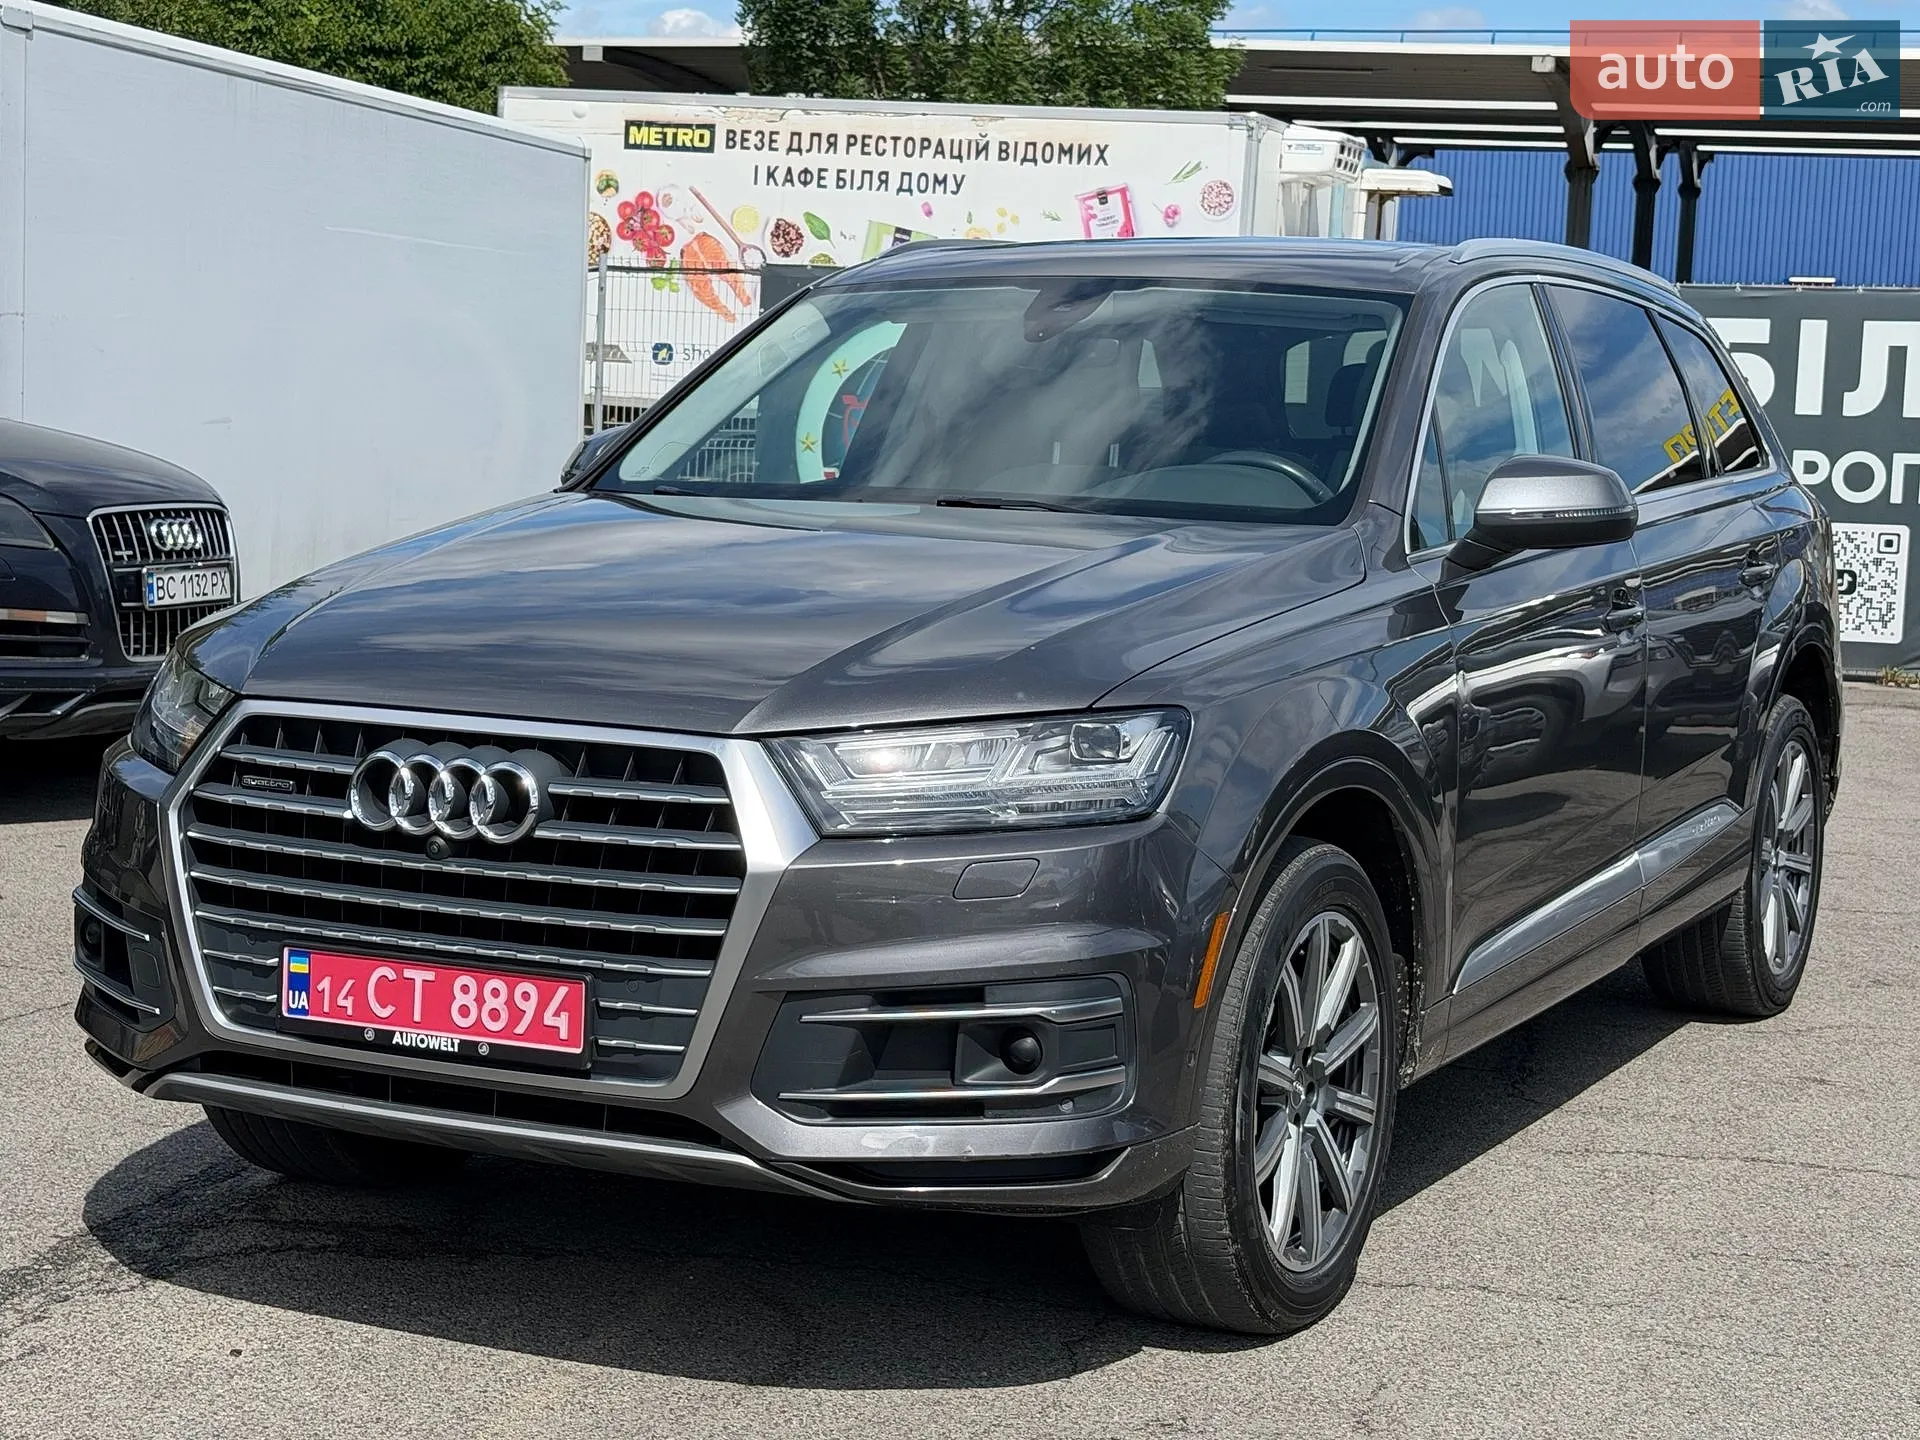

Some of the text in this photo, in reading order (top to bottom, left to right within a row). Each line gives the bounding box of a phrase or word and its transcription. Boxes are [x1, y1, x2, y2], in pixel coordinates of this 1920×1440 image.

[628, 126, 711, 148] METRO
[725, 129, 1110, 167] ВЕЗЕ ДЛЯ РЕСТОРАЦІЙ ВІДОМИХ
[766, 165, 829, 189] КАФЕ
[835, 168, 890, 192] БІЛЯ
[896, 171, 966, 197] ДОМУ
[156, 570, 228, 601] BC 1132 PX
[243, 778, 290, 788] quattro
[288, 990, 309, 1010] UA
[316, 966, 570, 1041] 14 CT 8894
[392, 1030, 461, 1053] AUTOWELT
